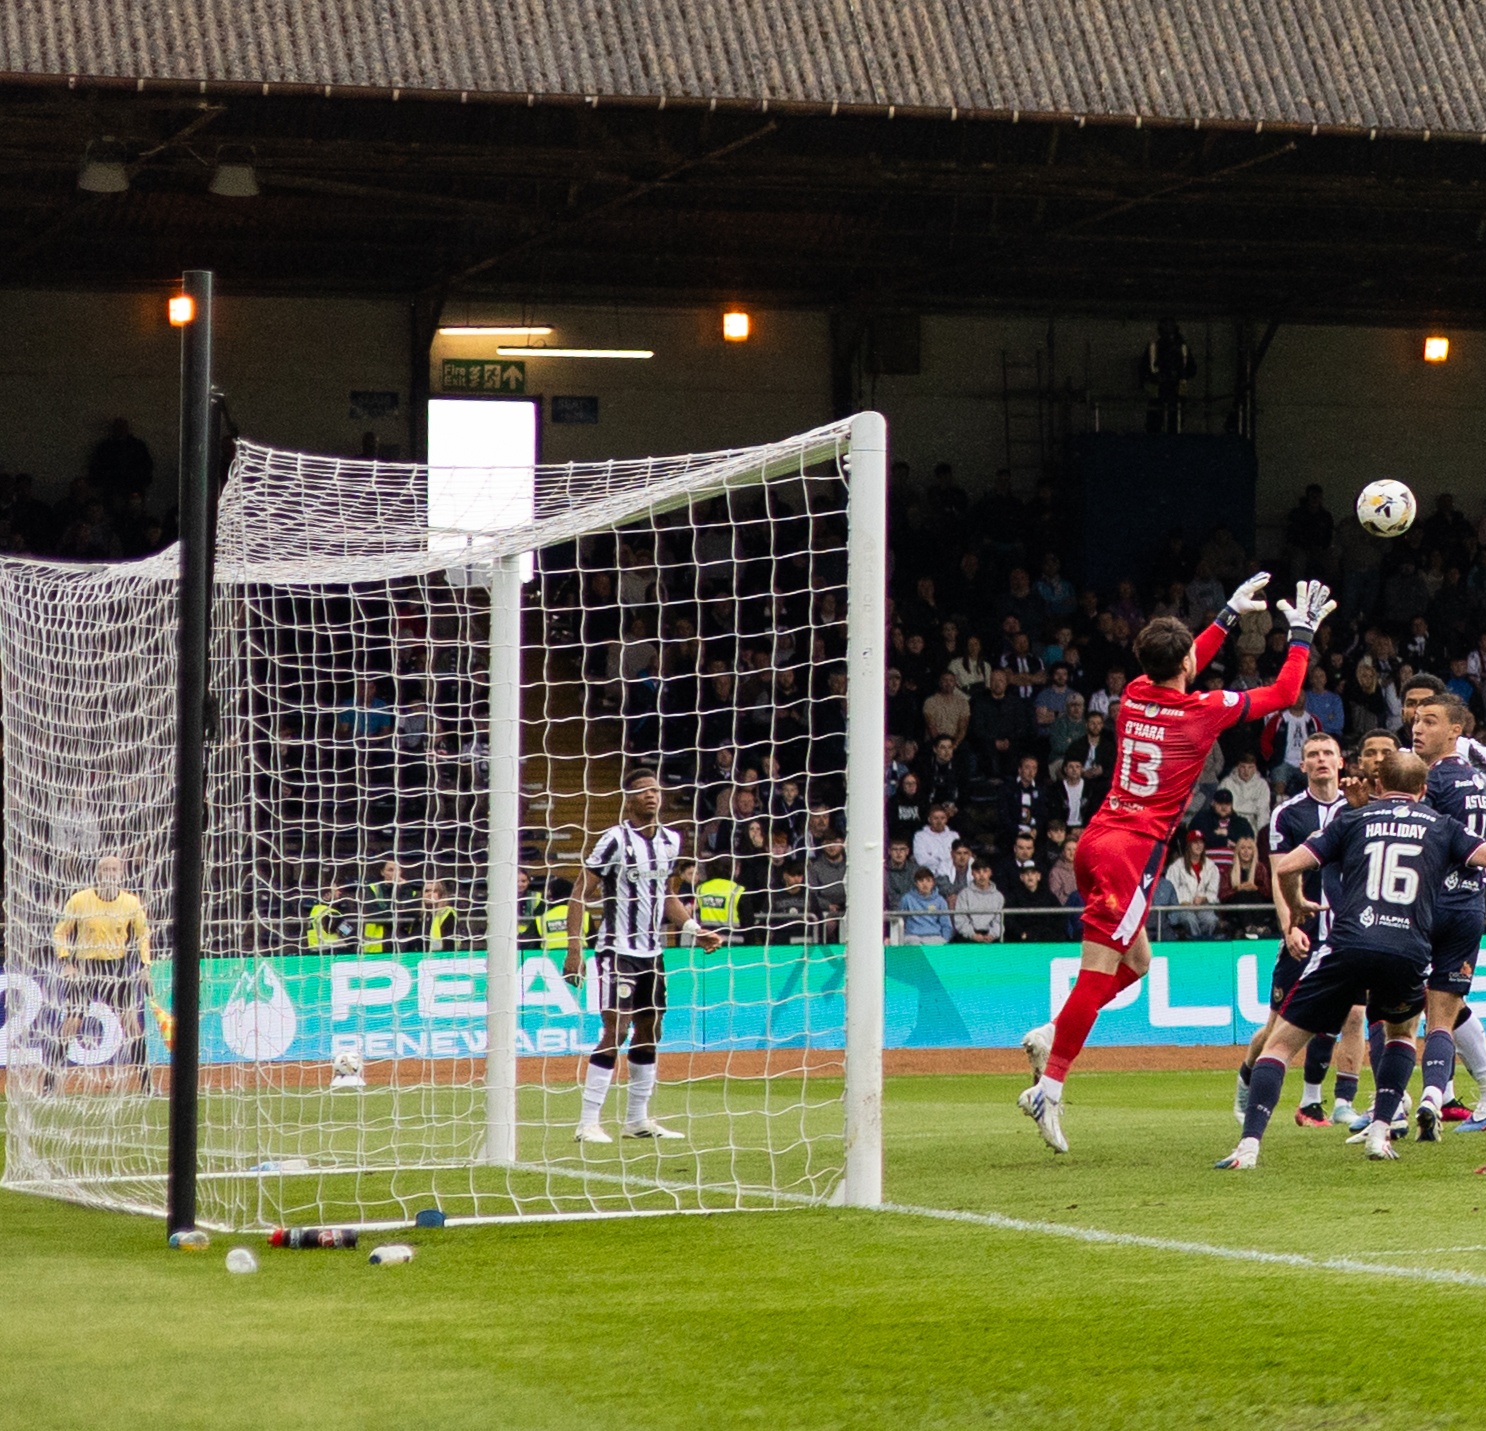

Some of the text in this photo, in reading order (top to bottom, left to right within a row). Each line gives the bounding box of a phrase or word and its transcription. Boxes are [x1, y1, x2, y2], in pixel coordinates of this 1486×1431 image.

[444, 364, 466, 376] Fire
[1125, 720, 1165, 741] O'HARA
[1120, 737, 1162, 798] 13
[1365, 822, 1427, 839] HALLIDAY
[1364, 841, 1423, 905] 16
[1379, 914, 1411, 926] ALPHA
